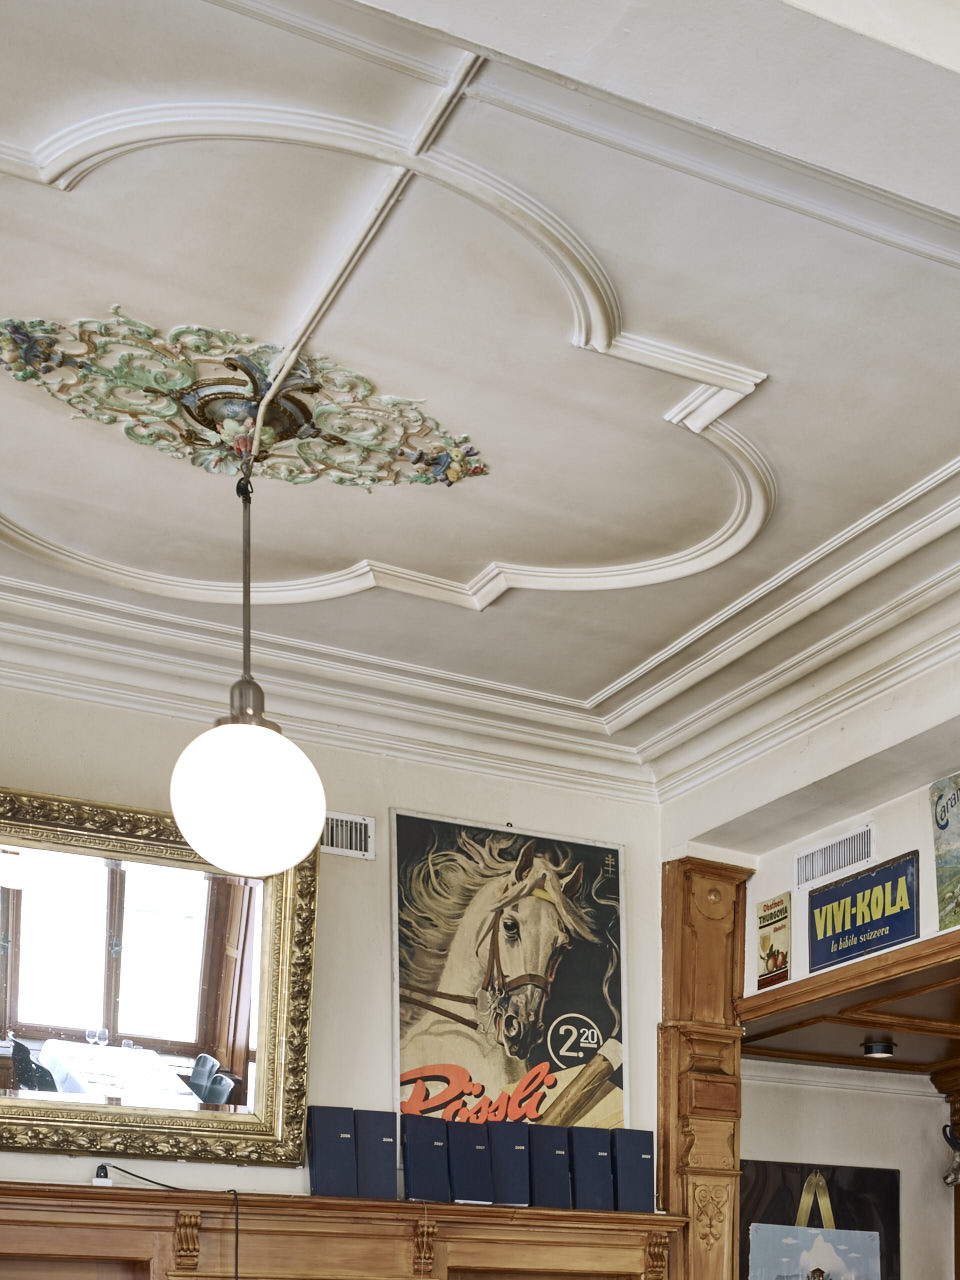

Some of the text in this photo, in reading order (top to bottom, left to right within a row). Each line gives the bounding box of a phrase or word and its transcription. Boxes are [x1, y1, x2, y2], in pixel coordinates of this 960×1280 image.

[759, 905, 788, 925] THURGOVIA
[813, 876, 911, 940] VIVI-KOLA
[831, 926, 890, 953] la bibita svizzera
